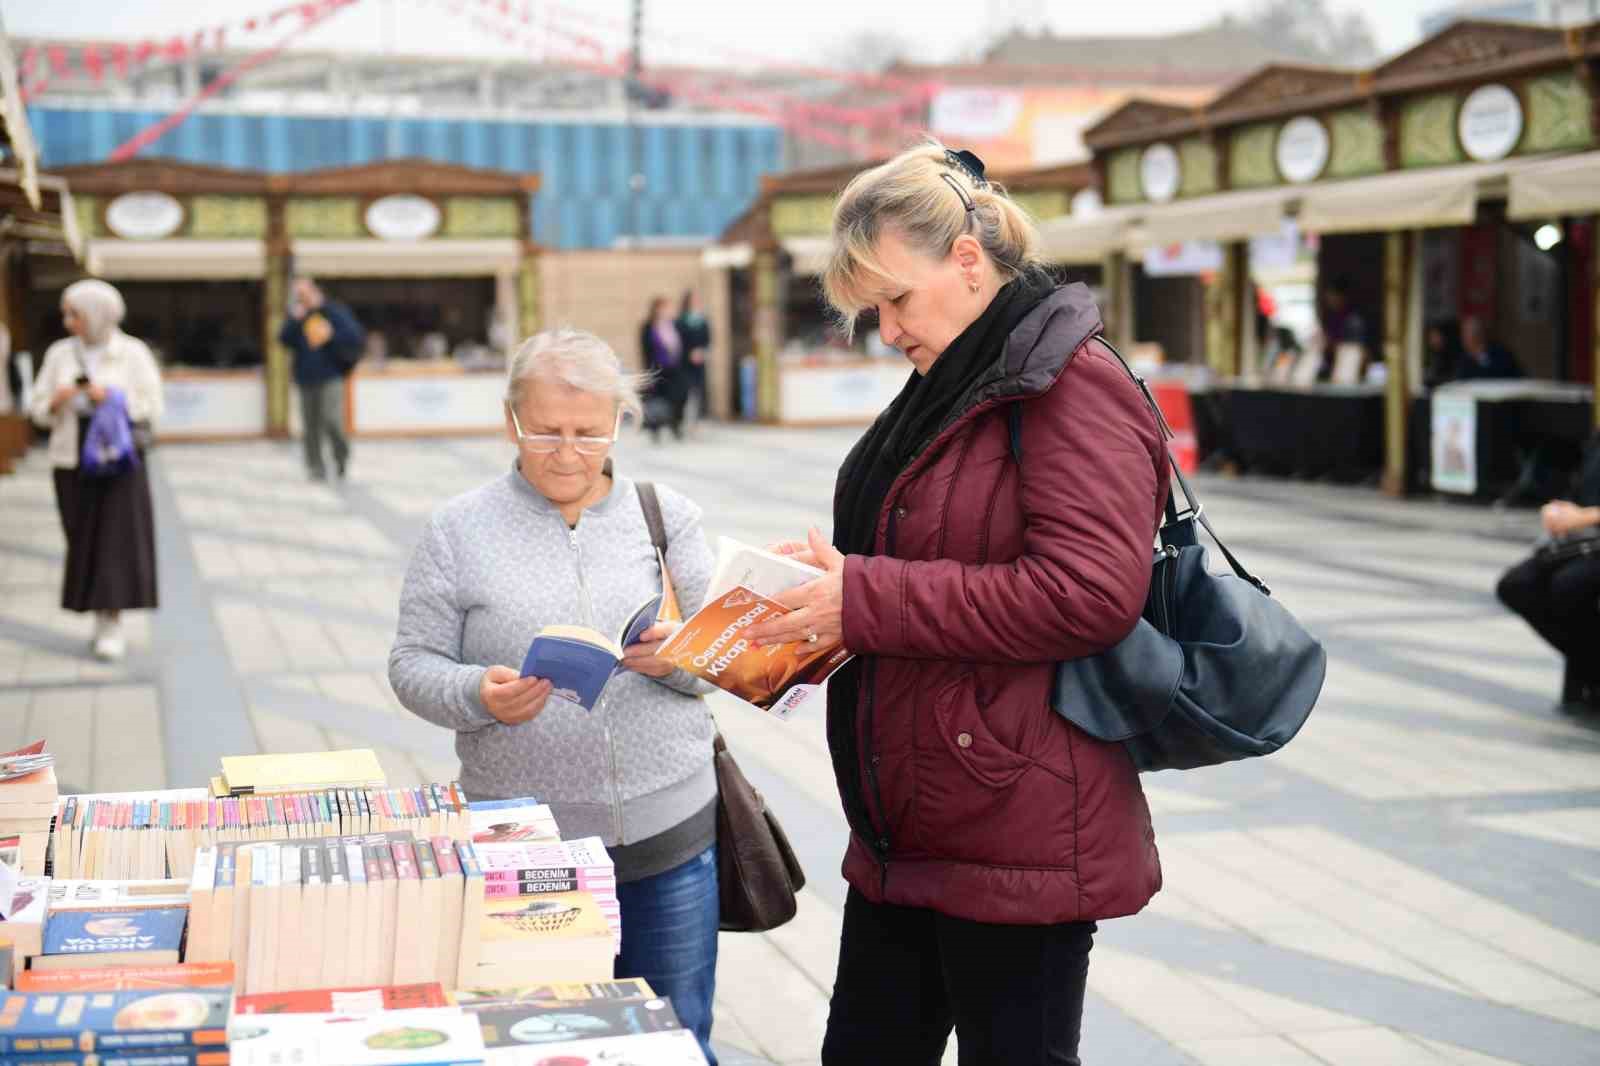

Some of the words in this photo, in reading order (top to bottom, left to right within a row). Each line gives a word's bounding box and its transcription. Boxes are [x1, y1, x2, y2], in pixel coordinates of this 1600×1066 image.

[692, 603, 769, 667] Osmangazi
[707, 638, 750, 677] Kitap
[525, 868, 569, 879] BEDENİM
[526, 880, 571, 892] BEDENİM
